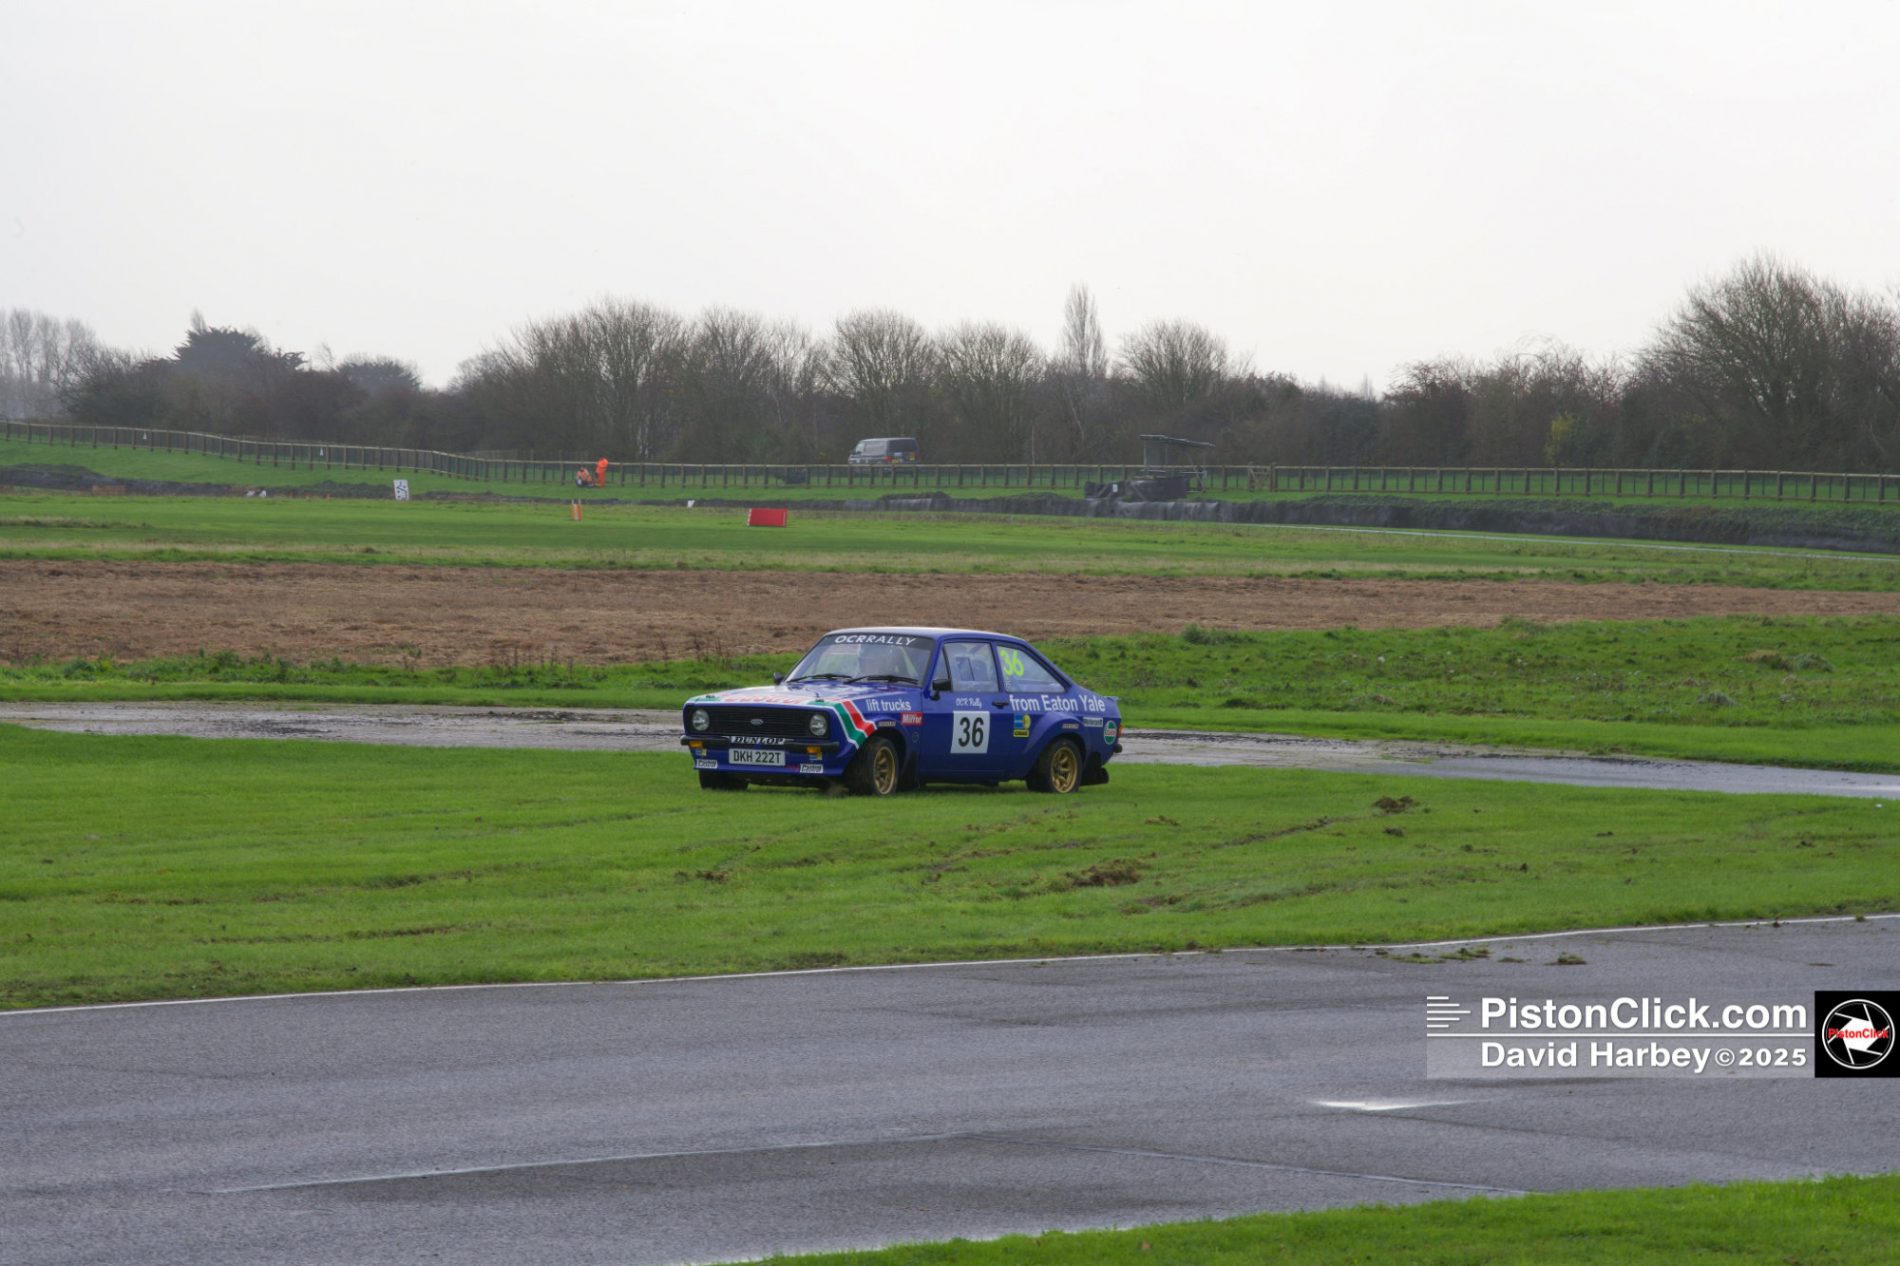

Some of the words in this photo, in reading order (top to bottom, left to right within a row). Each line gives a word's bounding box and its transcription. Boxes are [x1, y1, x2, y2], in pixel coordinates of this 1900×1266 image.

[1000, 649, 1025, 677] 36
[865, 698, 880, 712] lift
[880, 698, 912, 712] trucks
[1009, 694, 1041, 711] from
[1041, 694, 1079, 712] Eaton
[1079, 694, 1106, 712] Yale
[958, 716, 984, 748] 36
[733, 750, 753, 762] DKH
[755, 751, 781, 764] 222T
